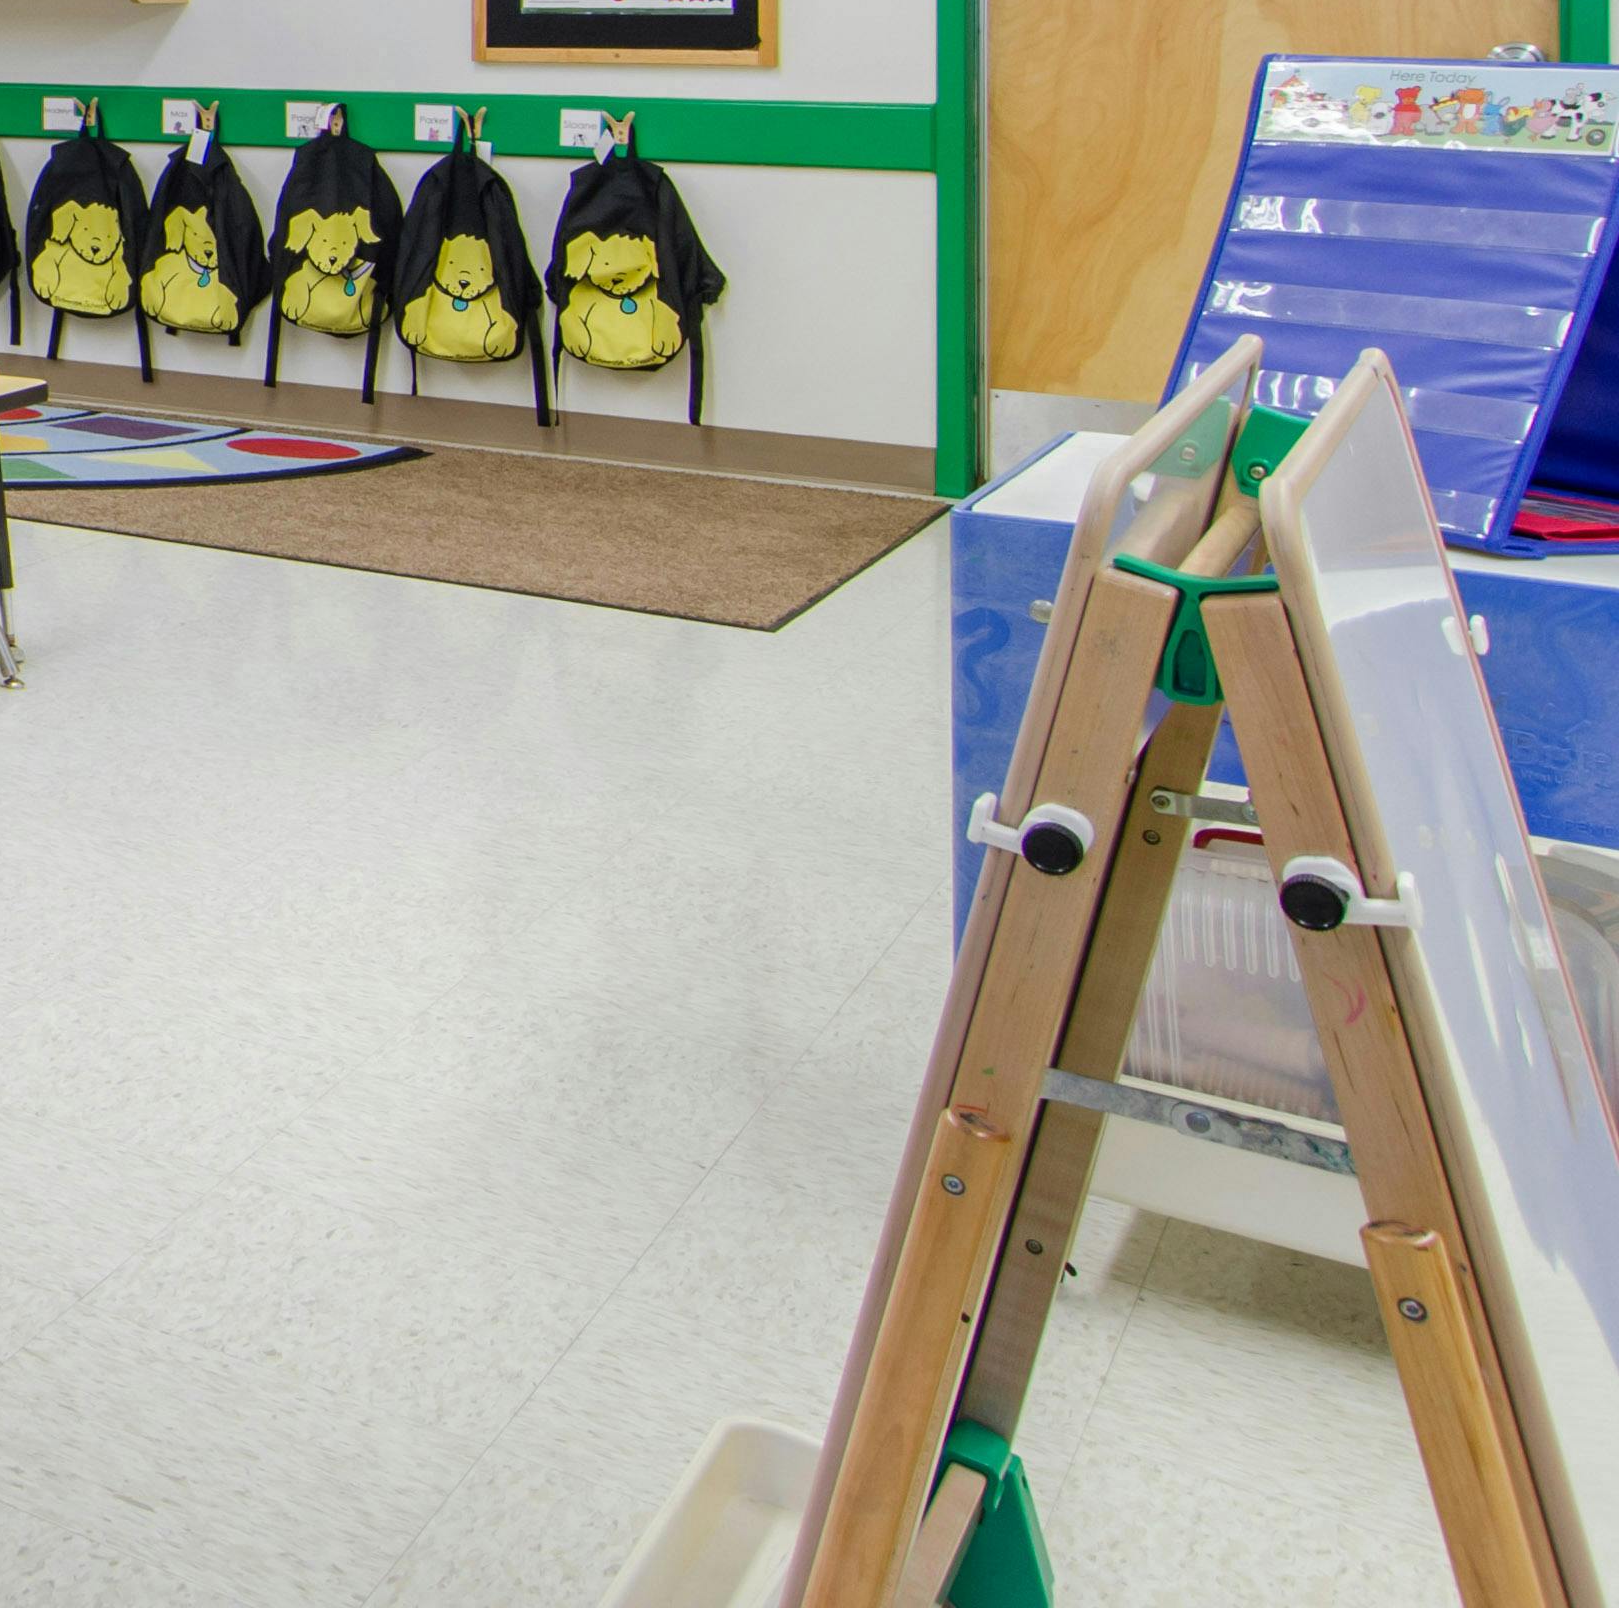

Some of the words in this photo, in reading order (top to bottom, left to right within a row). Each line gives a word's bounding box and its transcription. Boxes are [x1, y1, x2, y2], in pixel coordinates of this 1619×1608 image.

[1390, 69, 1426, 83] Here
[1428, 70, 1478, 86] Today
[419, 115, 450, 124] Parker
[563, 120, 598, 130] Sloane
